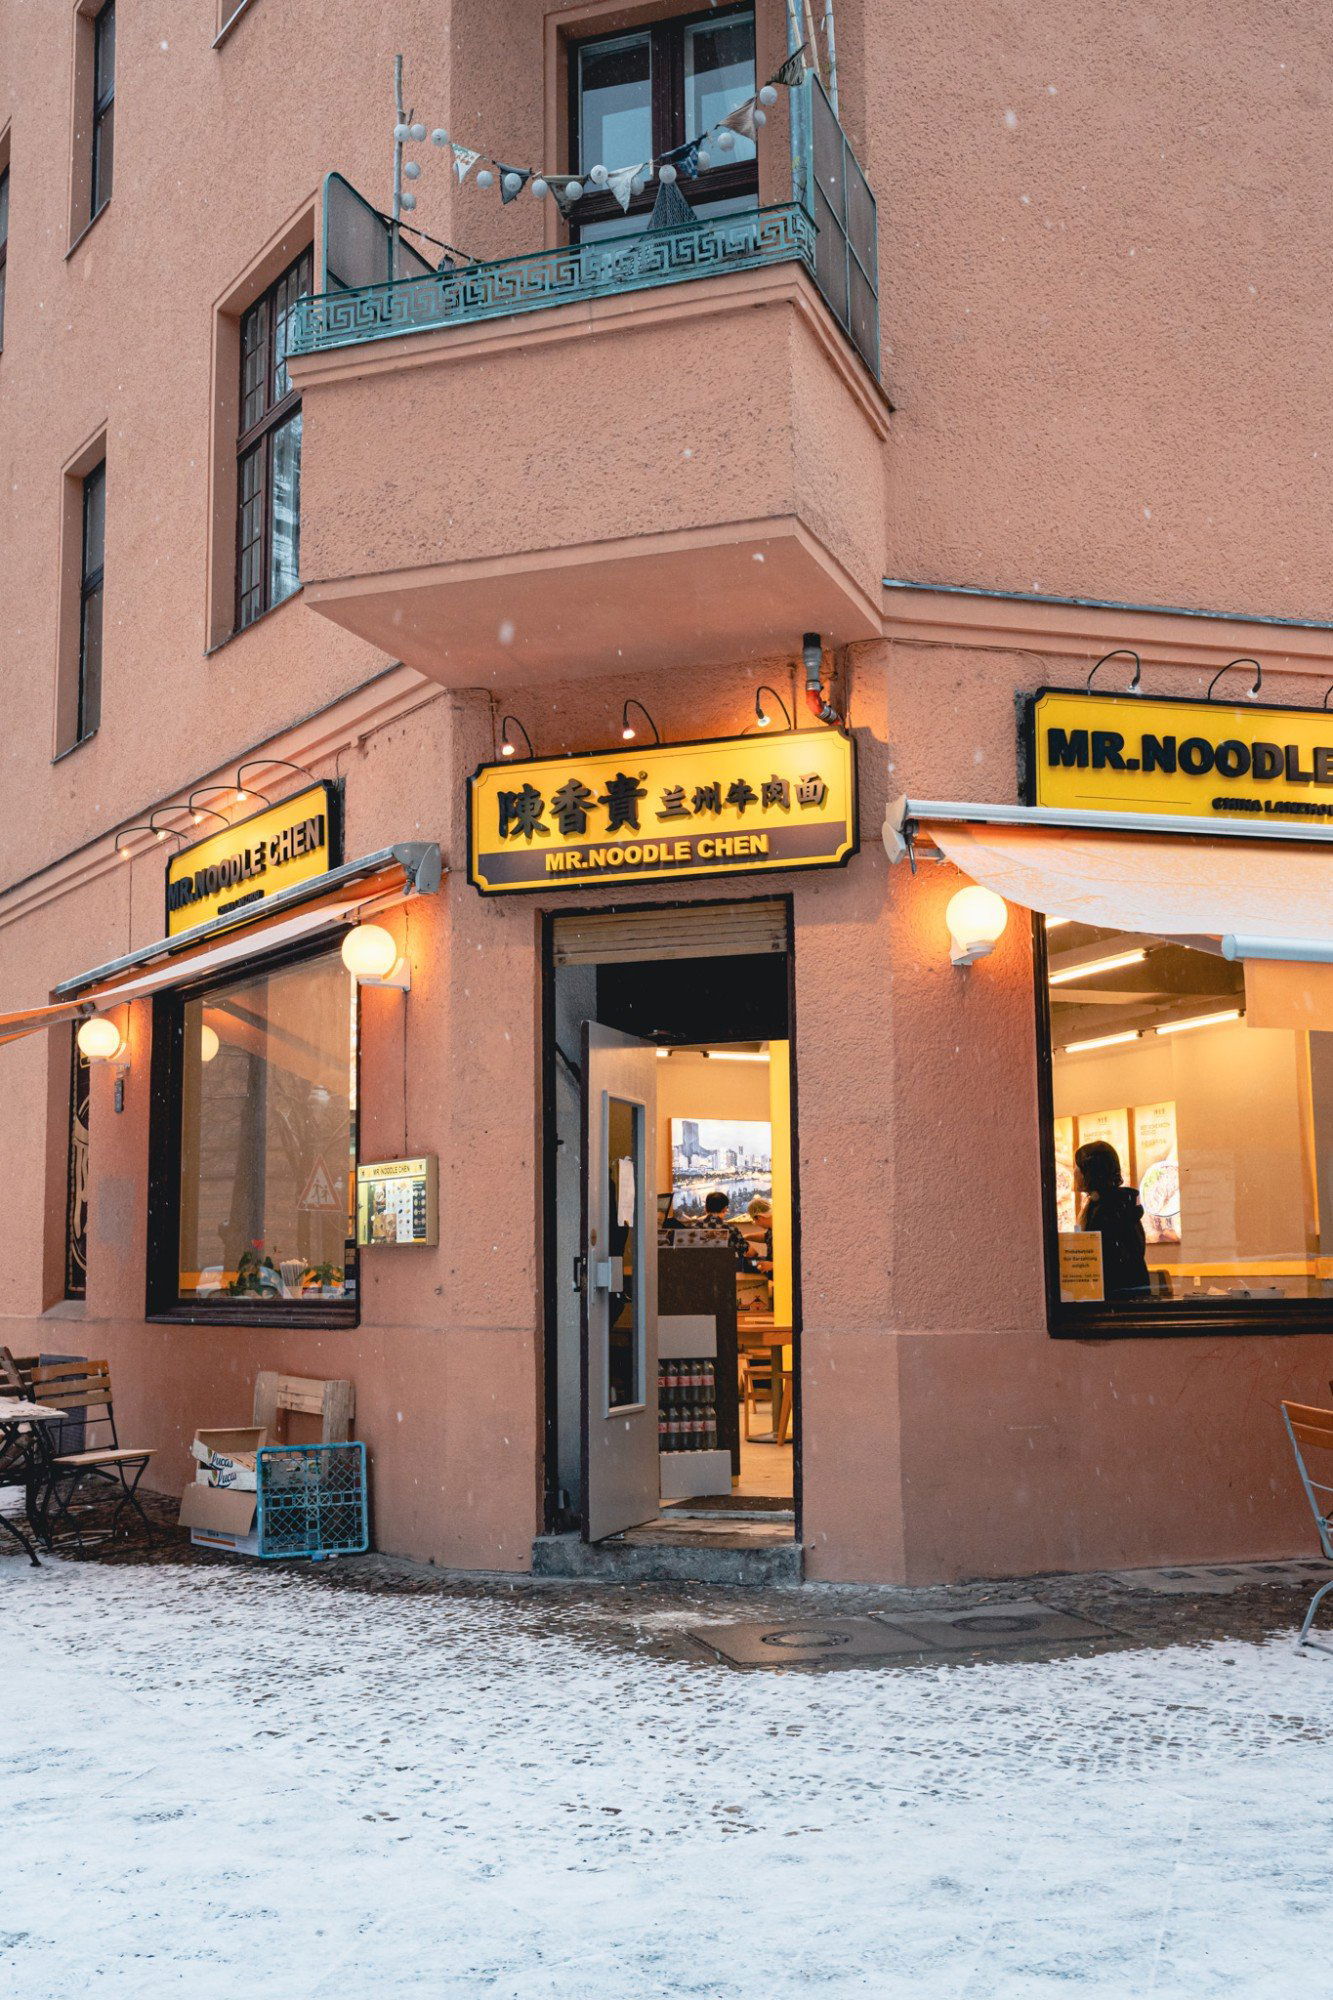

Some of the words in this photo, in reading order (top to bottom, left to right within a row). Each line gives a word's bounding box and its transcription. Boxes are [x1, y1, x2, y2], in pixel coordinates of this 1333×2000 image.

[1048, 727, 1333, 785] MR.NOODLE
[497, 772, 648, 838] 陳香貴
[655, 772, 828, 819] 兰州牛肉面
[167, 841, 266, 911] MR.NOODLE
[269, 814, 325, 867] CHEN
[545, 841, 692, 871] MR.NOODLE
[698, 834, 769, 858] CHEN
